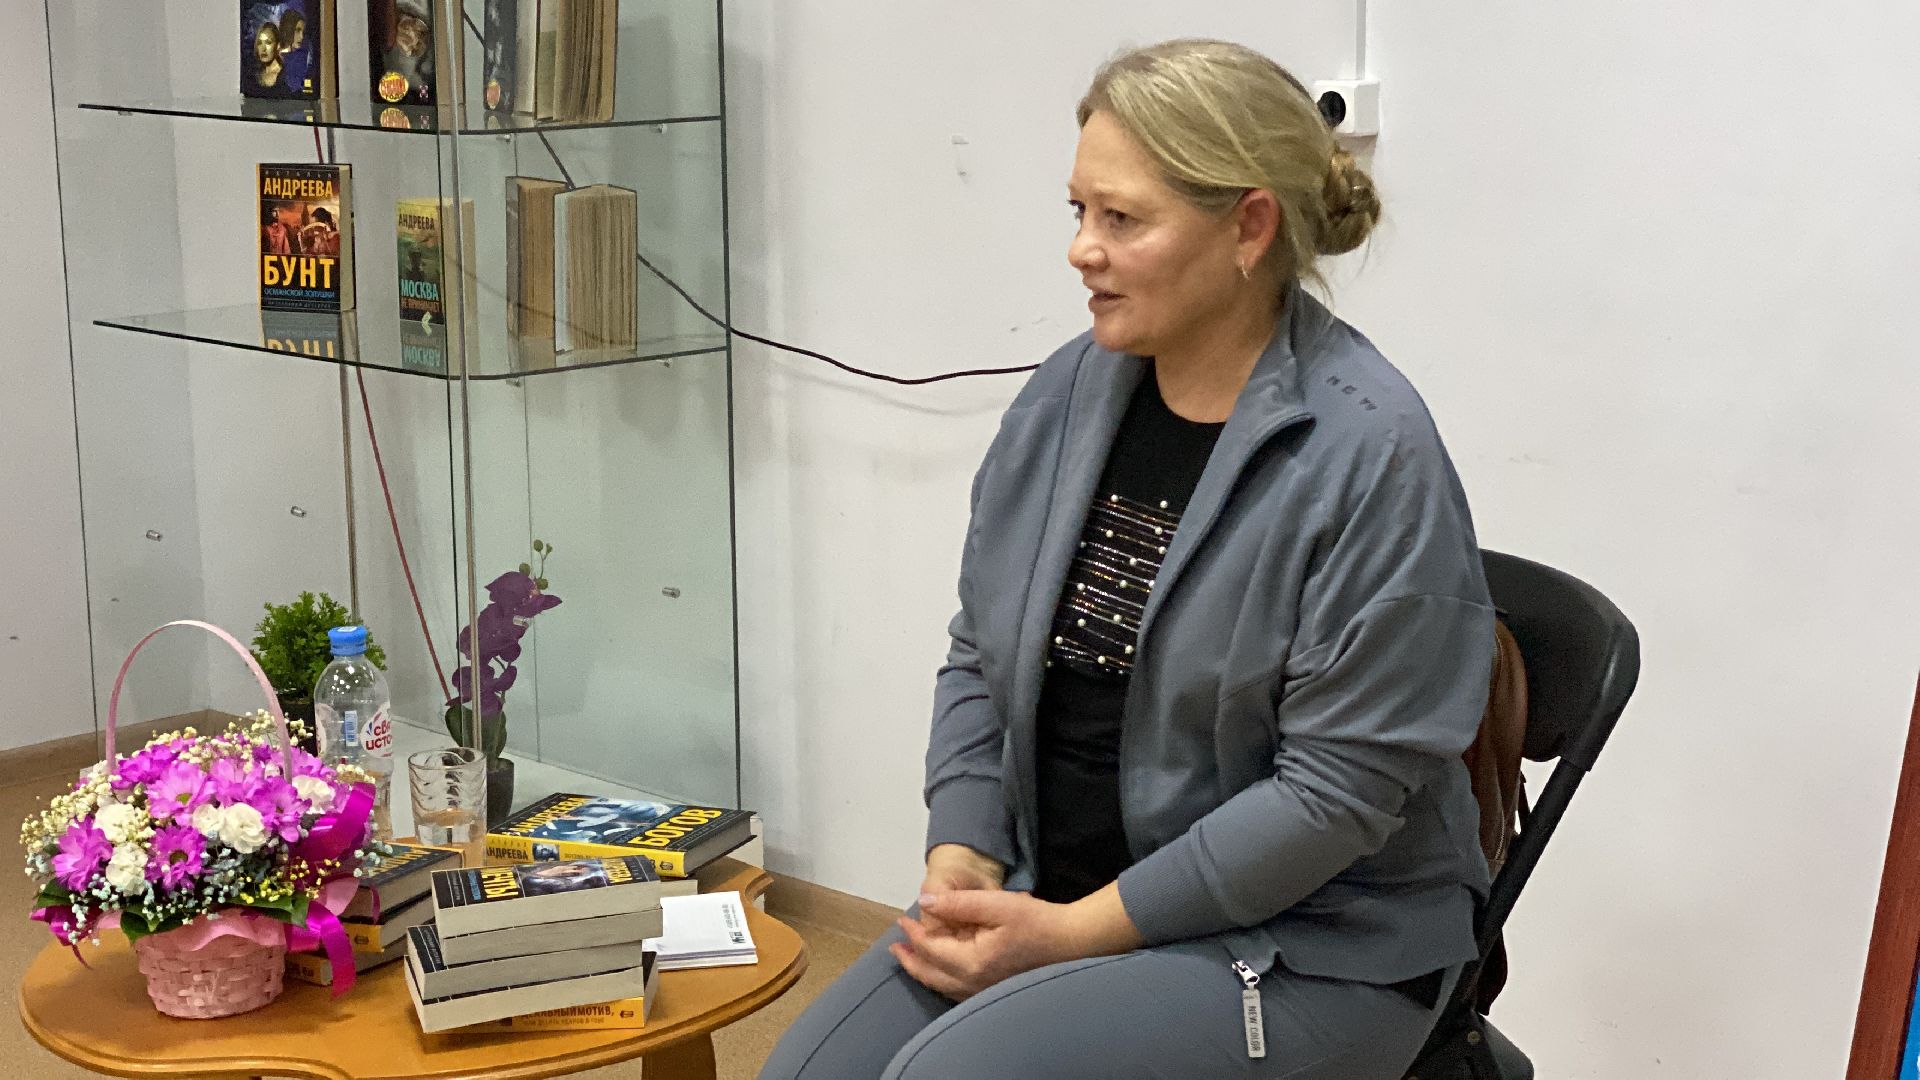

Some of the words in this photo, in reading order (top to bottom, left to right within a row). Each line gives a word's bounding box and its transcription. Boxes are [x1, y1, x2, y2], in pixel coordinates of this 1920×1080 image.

[264, 178, 333, 199] АНДРЕЕВА
[399, 213, 435, 231] АНДРЕЕВА
[264, 255, 334, 288] БУНТ
[401, 279, 439, 301] МОСКВА
[628, 809, 723, 847] БОГОВ
[579, 1005, 615, 1017] МОТИВ,
[1248, 1005, 1258, 1024] NEW
